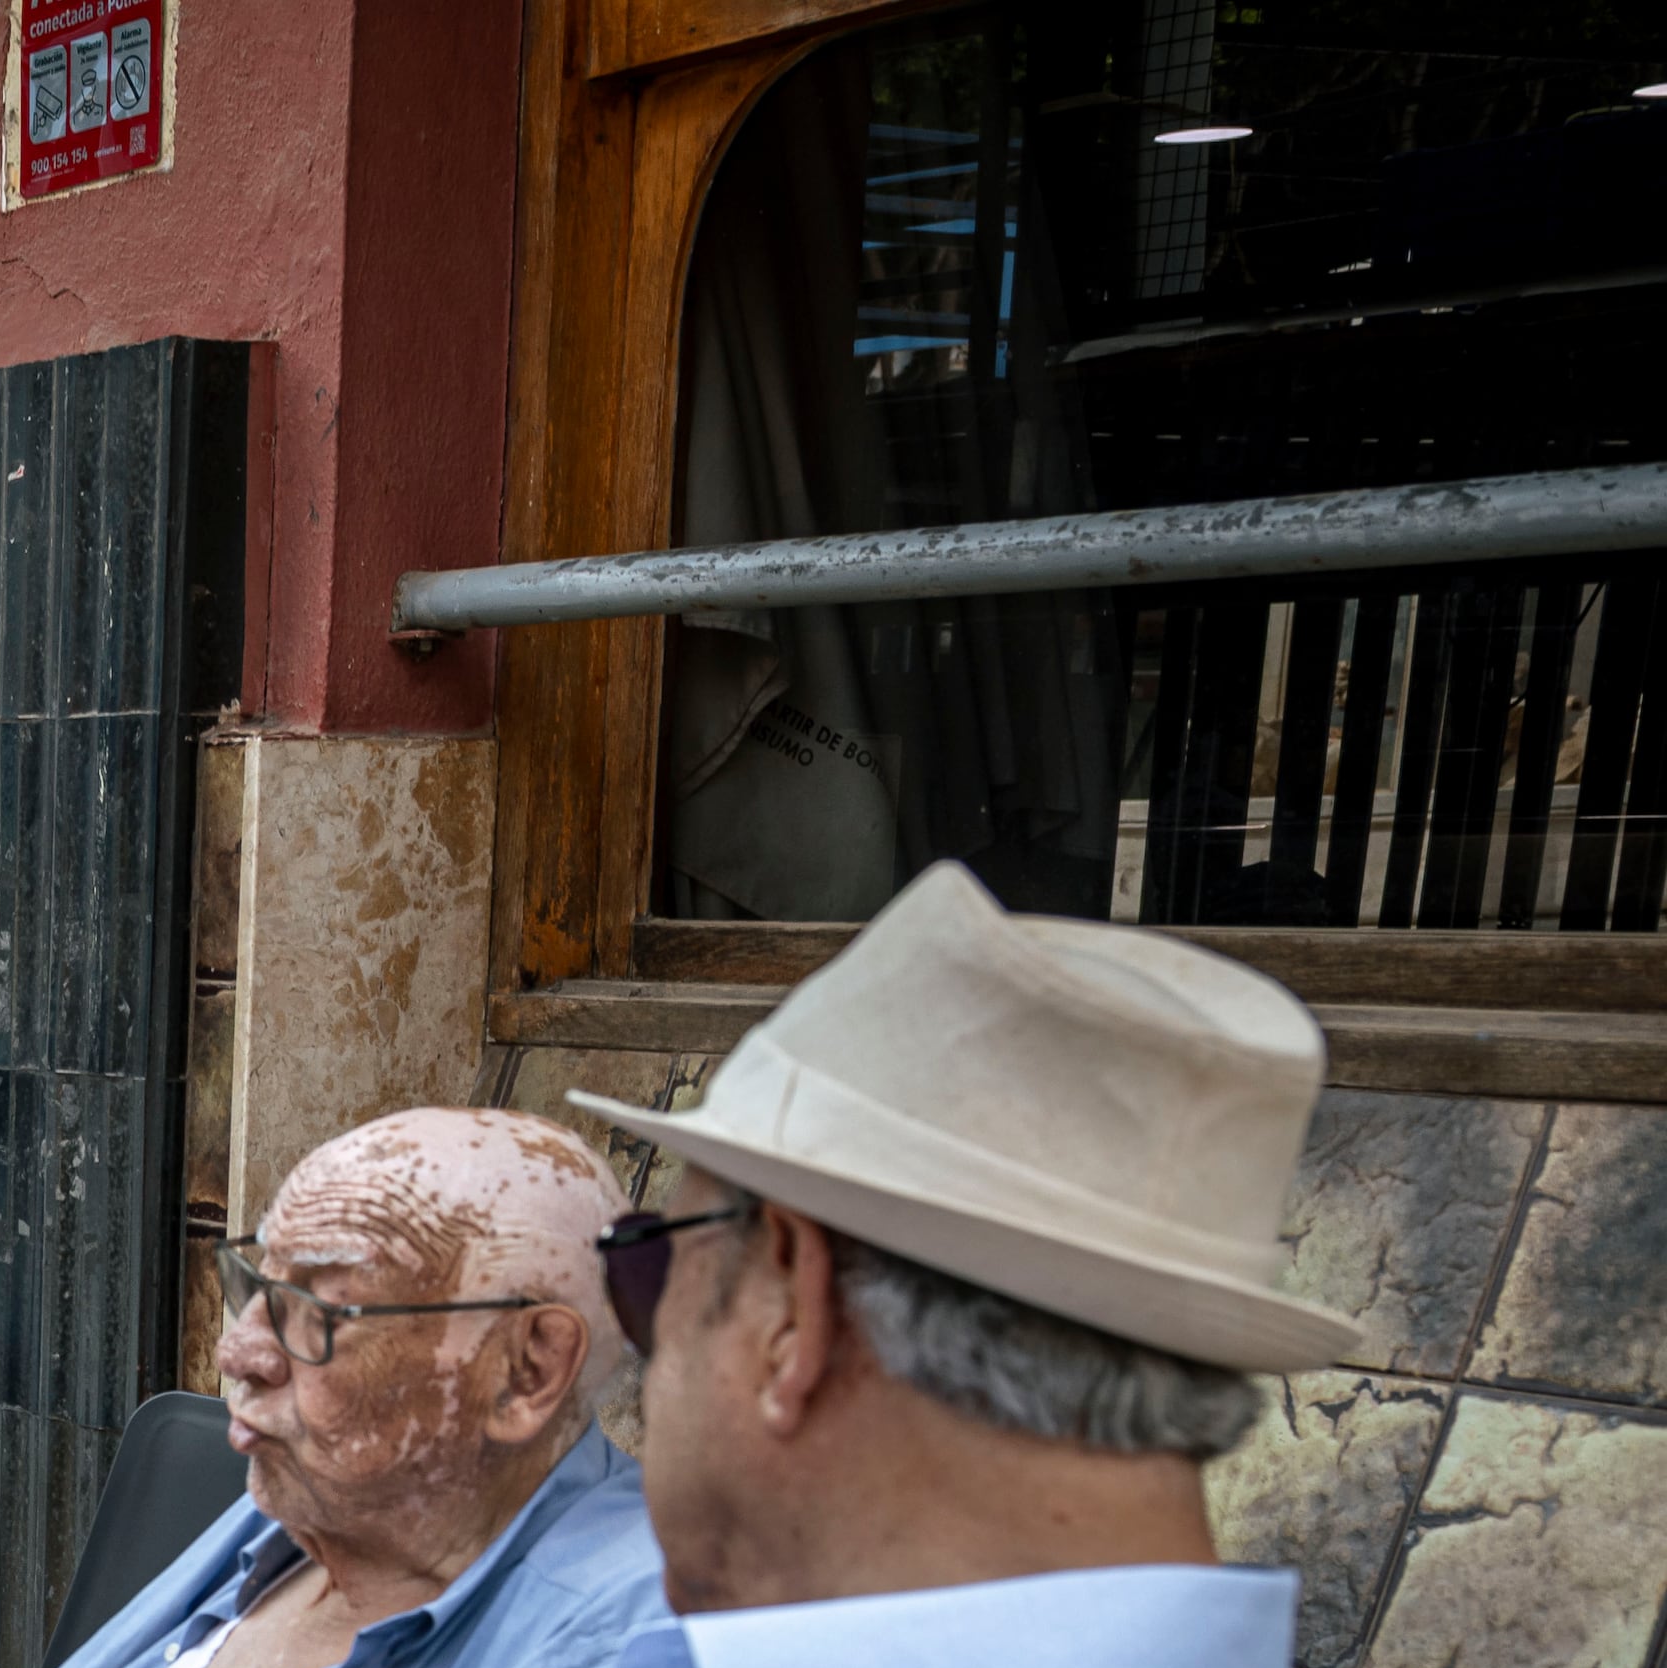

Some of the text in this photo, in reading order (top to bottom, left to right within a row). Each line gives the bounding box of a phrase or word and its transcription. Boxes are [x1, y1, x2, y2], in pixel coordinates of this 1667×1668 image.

[30, 1, 94, 38] conectada
[96, 5, 105, 17] a
[120, 27, 142, 41] Alarma
[31, 158, 50, 176] 900
[52, 153, 68, 169] 154
[71, 147, 88, 163] 154
[815, 726, 844, 751] DE
